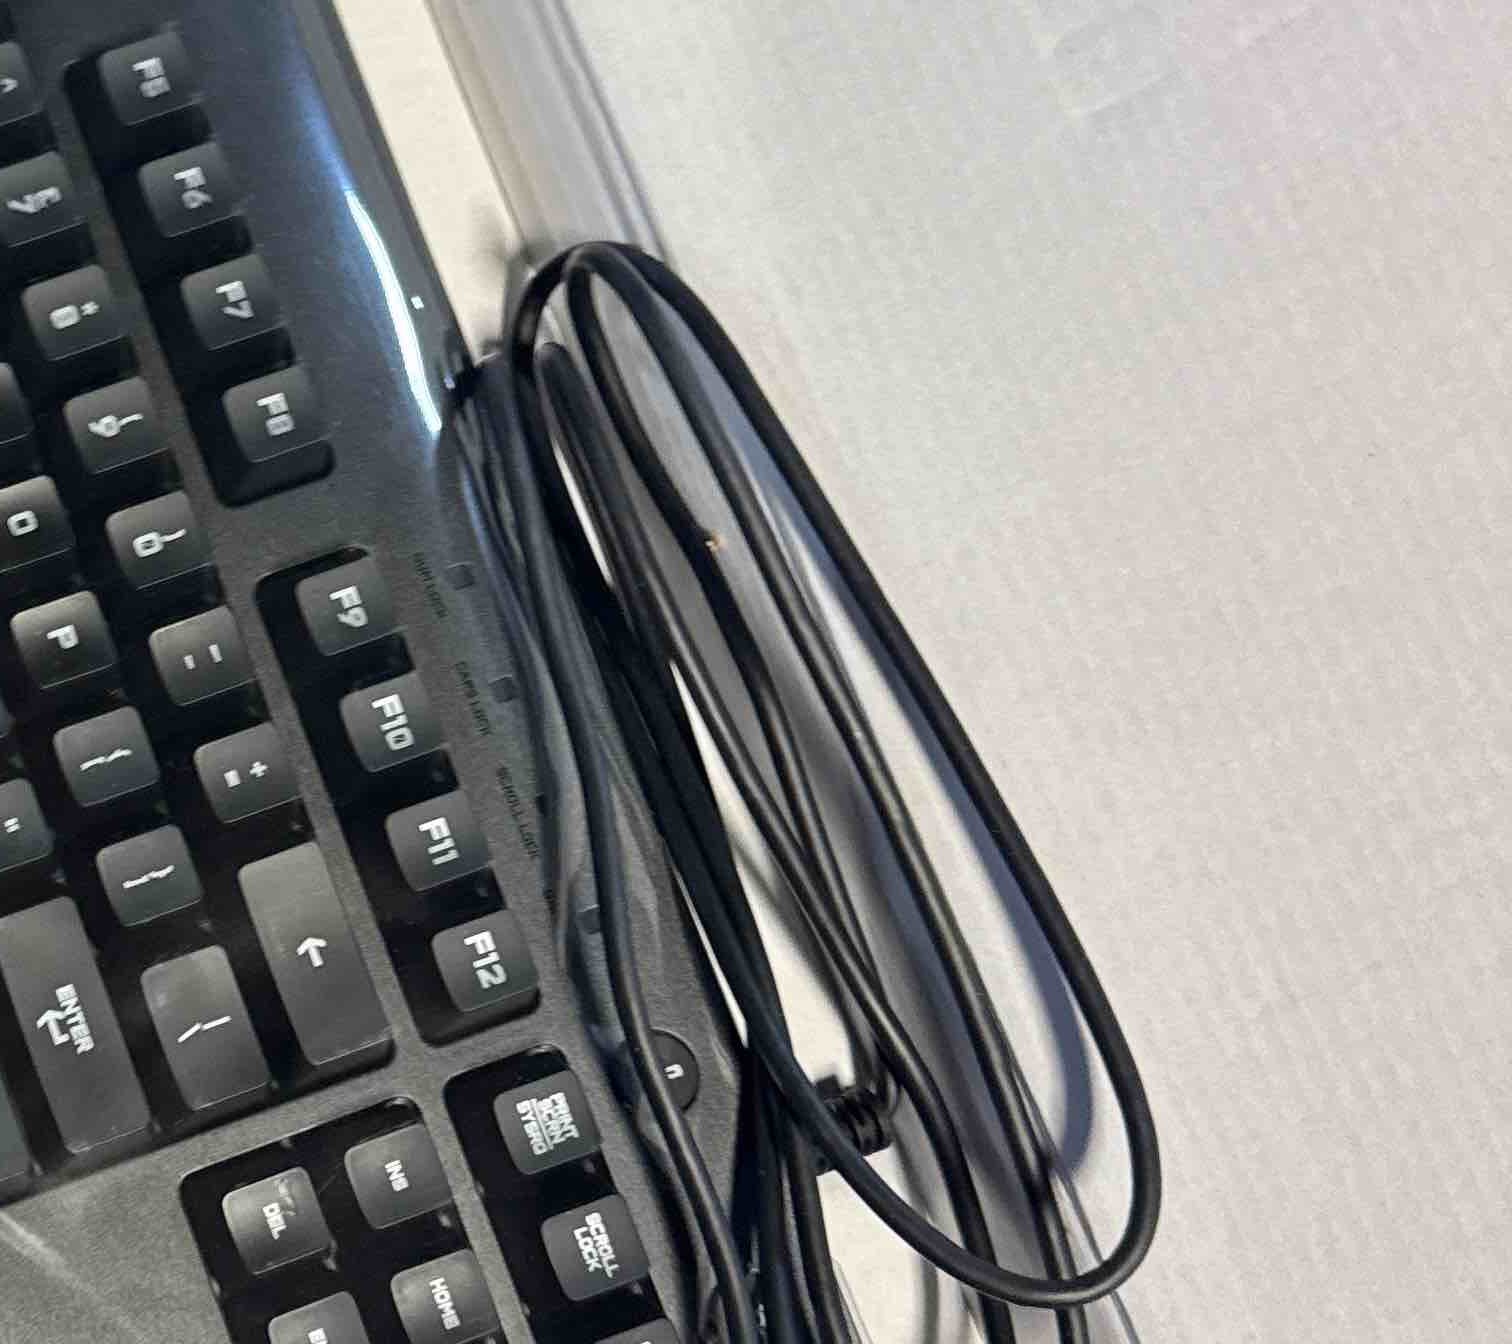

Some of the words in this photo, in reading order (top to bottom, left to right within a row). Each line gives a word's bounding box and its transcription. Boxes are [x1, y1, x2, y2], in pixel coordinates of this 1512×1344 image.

[132, 56, 170, 97] F5
[173, 166, 210, 209] F6
[49, 304, 80, 329] 8
[215, 280, 253, 318] F7
[87, 414, 124, 438] 9
[255, 392, 293, 435] F8
[6, 510, 38, 536] O
[132, 531, 165, 557] 0
[329, 585, 367, 627] F9
[46, 624, 78, 649] P
[371, 693, 413, 750] F10
[418, 816, 458, 865] F11
[463, 930, 506, 989] F12
[55, 983, 95, 1054] ENTER
[384, 1159, 409, 1192] INS
[262, 1202, 287, 1240] DEL
[573, 1226, 602, 1272] LOCK
[585, 1212, 619, 1278] SCROLL
[431, 1276, 459, 1329] HOME
